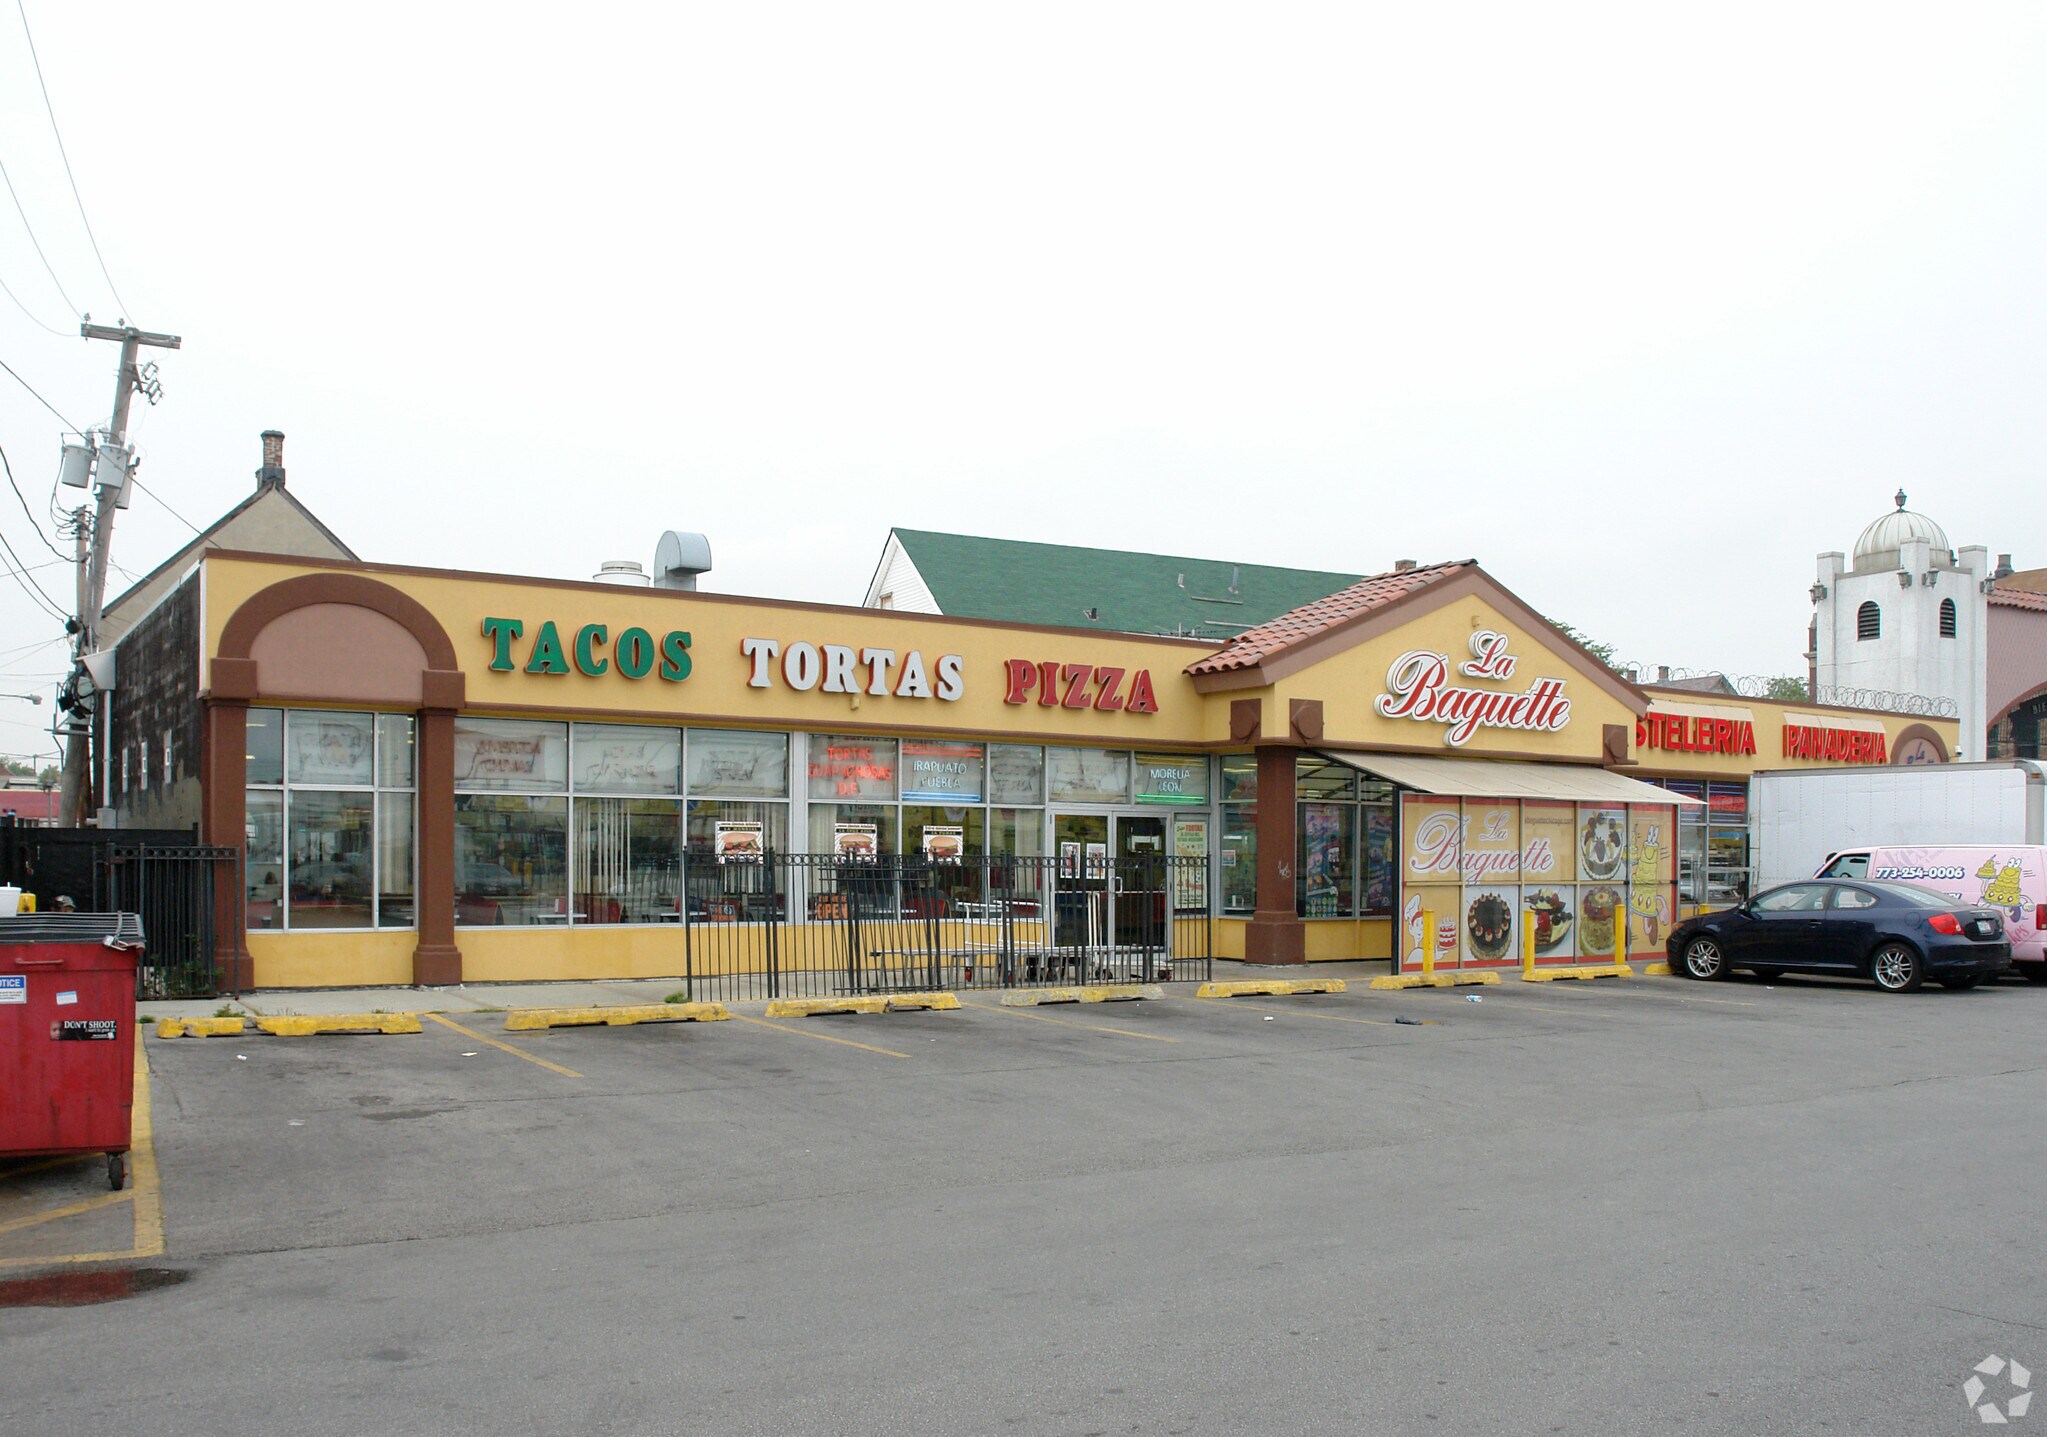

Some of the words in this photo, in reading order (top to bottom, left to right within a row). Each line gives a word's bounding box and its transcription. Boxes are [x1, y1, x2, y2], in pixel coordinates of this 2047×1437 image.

[481, 617, 693, 682] TACOS
[1457, 629, 1518, 680] La
[740, 637, 964, 701] TORTAS
[1004, 658, 1160, 713] PIZZA
[1374, 650, 1571, 747] Baguette
[1636, 711, 1757, 755] STELERIA
[1783, 724, 1887, 764] PANADERIA
[828, 746, 873, 761] TORTAS
[913, 760, 967, 775] IRAPUATO
[921, 776, 961, 789] PUEBLA
[1150, 768, 1190, 781] MORELIA
[1158, 781, 1182, 793] LEON
[1479, 809, 1511, 842] La
[1411, 810, 1554, 888] Baguette
[1875, 865, 1966, 880] 773-254-0006
[817, 903, 848, 920] OPEN
[64, 1020, 87, 1029] DON'T
[88, 1020, 117, 1029] SHOOT.
